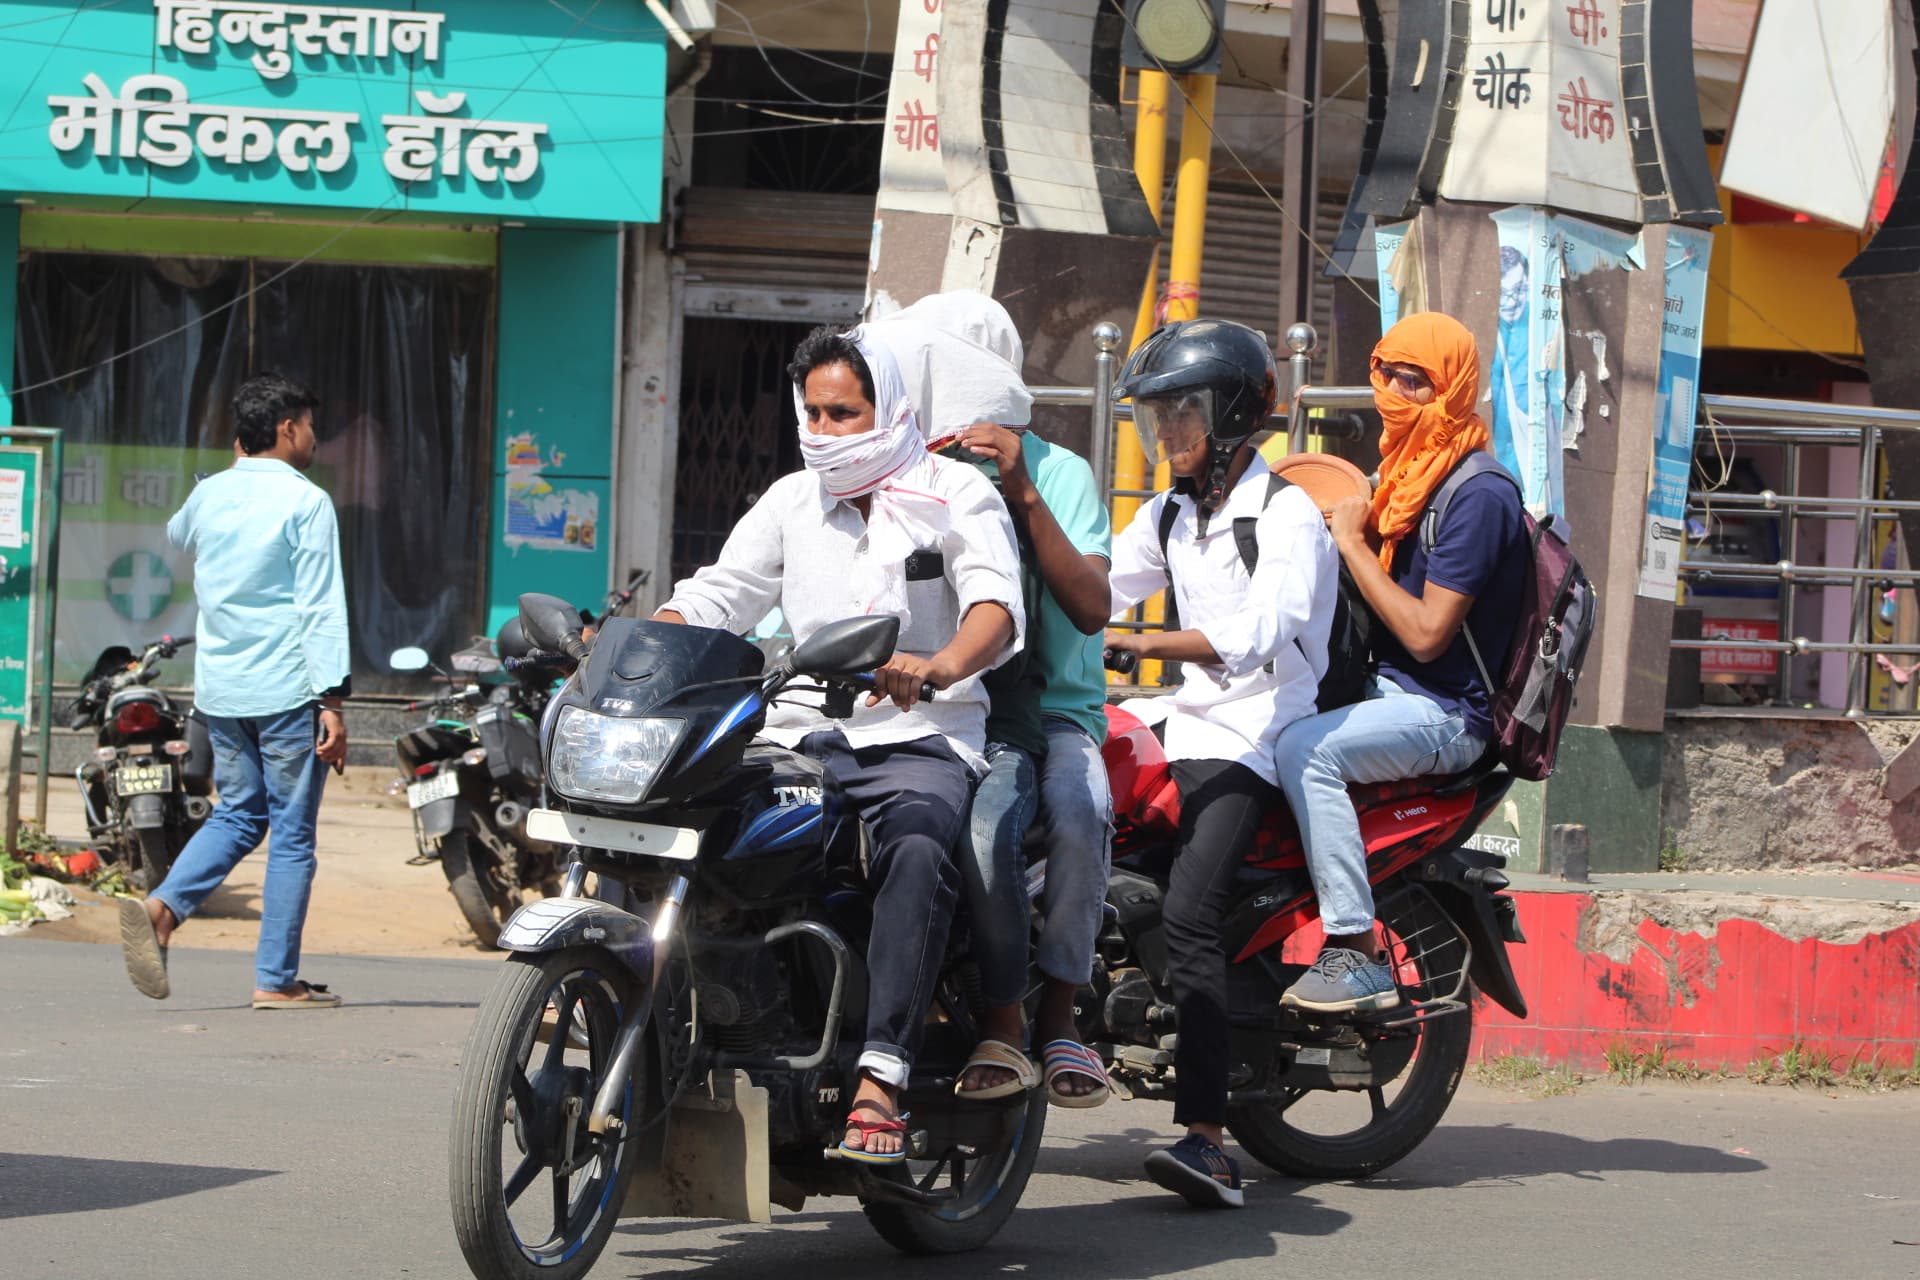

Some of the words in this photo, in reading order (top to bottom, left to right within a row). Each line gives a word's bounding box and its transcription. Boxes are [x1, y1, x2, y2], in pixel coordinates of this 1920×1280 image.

[1472, 50, 1531, 110] चौक
[48, 72, 359, 173] मेडिकल
[381, 90, 548, 182] हॉल
[1557, 76, 1615, 144] चौक
[601, 697, 634, 711] TVS
[773, 786, 822, 807] TVS
[818, 1087, 840, 1103] TVS
